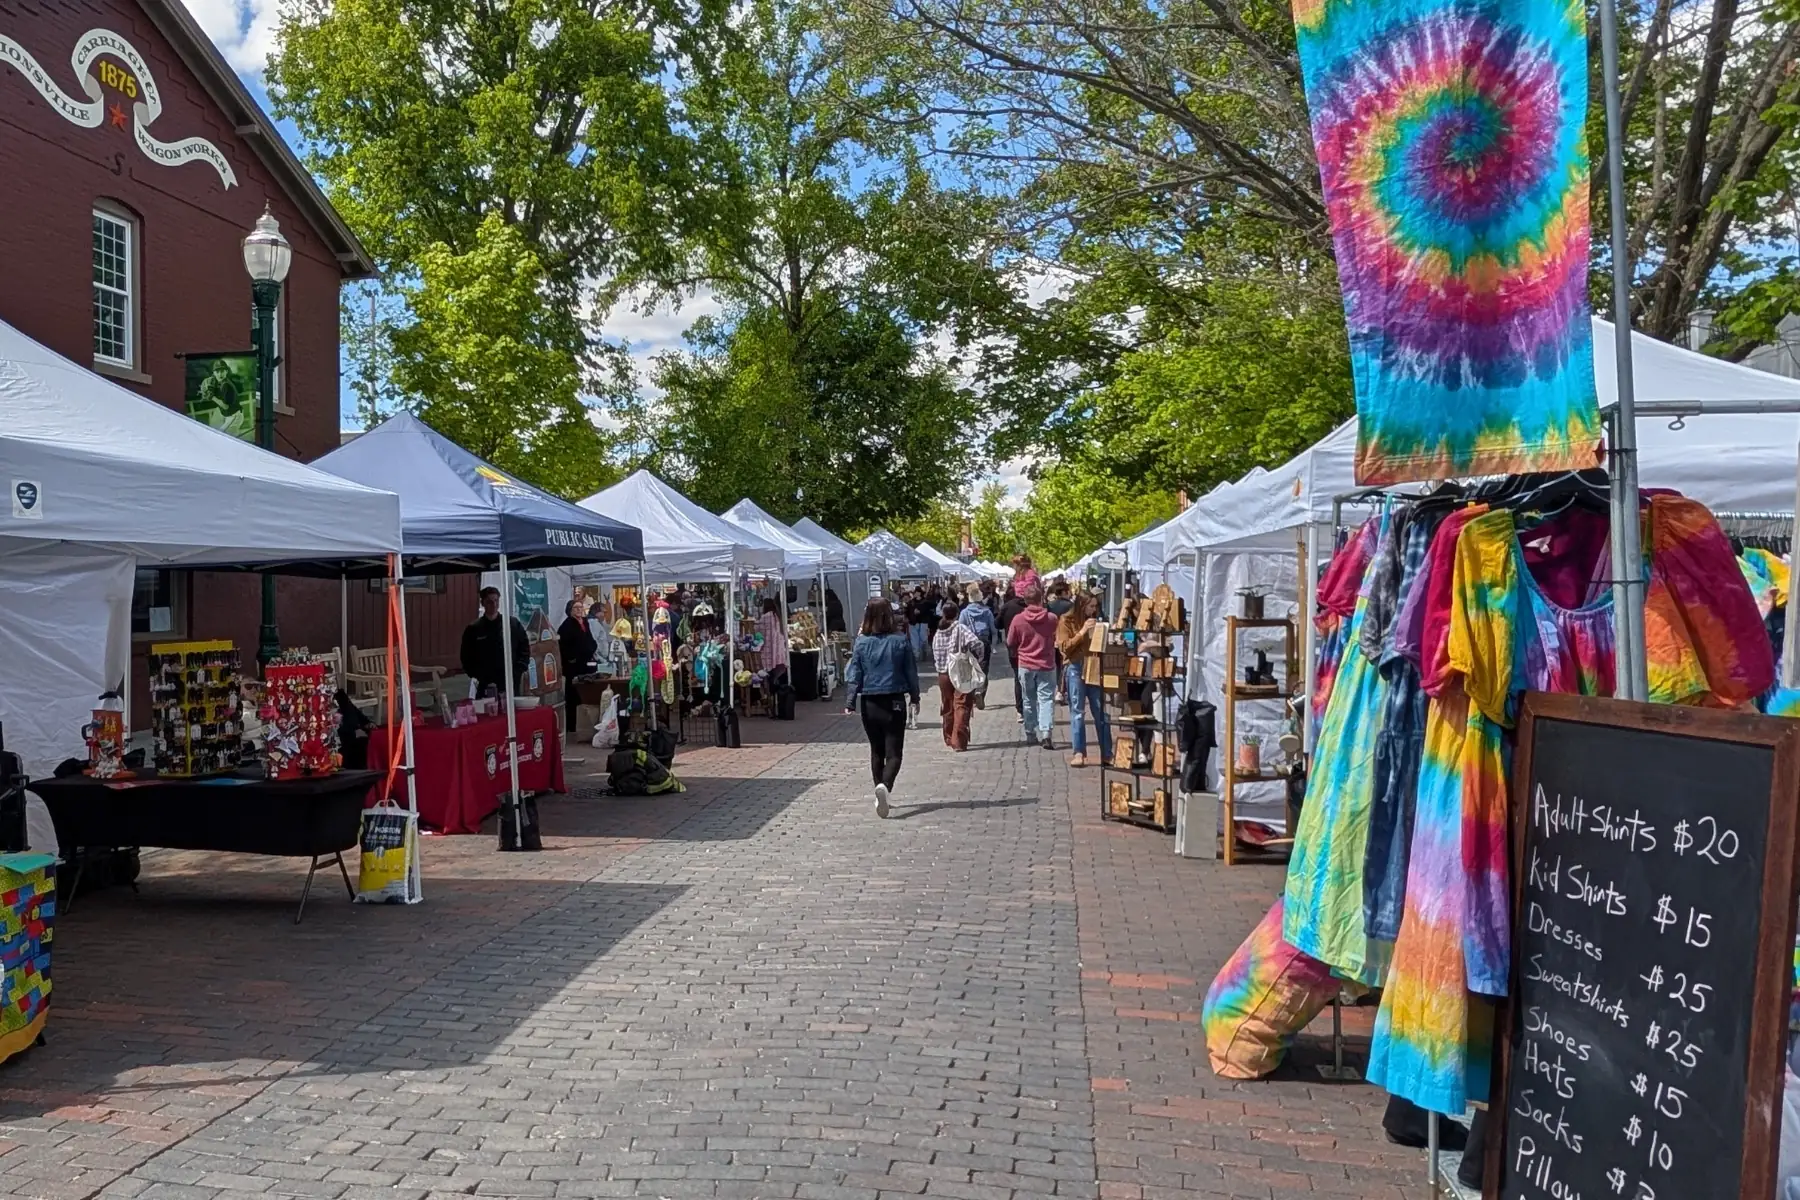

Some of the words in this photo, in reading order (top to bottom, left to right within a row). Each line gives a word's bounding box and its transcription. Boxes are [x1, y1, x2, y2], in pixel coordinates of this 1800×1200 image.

[77, 36, 147, 78] CARRIAGE
[137, 126, 181, 159] WAGON
[182, 143, 227, 174] WORKS
[99, 60, 137, 98] 1875
[544, 528, 582, 548] PUBLIC
[582, 532, 614, 551] SAFETY
[1534, 782, 1588, 838] Adult
[1590, 805, 1657, 852] Shirts
[1673, 815, 1740, 865] $20
[1529, 845, 1561, 893] Kid
[1566, 864, 1627, 915] Shirts
[1653, 893, 1713, 948] $15
[1528, 901, 1603, 961] Dresses
[1639, 964, 1713, 1012] $25
[1524, 1006, 1592, 1061] Shoes
[1630, 1072, 1689, 1119] $15
[1526, 953, 1630, 1028] Sweatshirts
[1645, 1020, 1704, 1068] $25
[1514, 1088, 1584, 1154] Socks
[1524, 1039, 1577, 1099] Hats
[1622, 1114, 1673, 1171] $10
